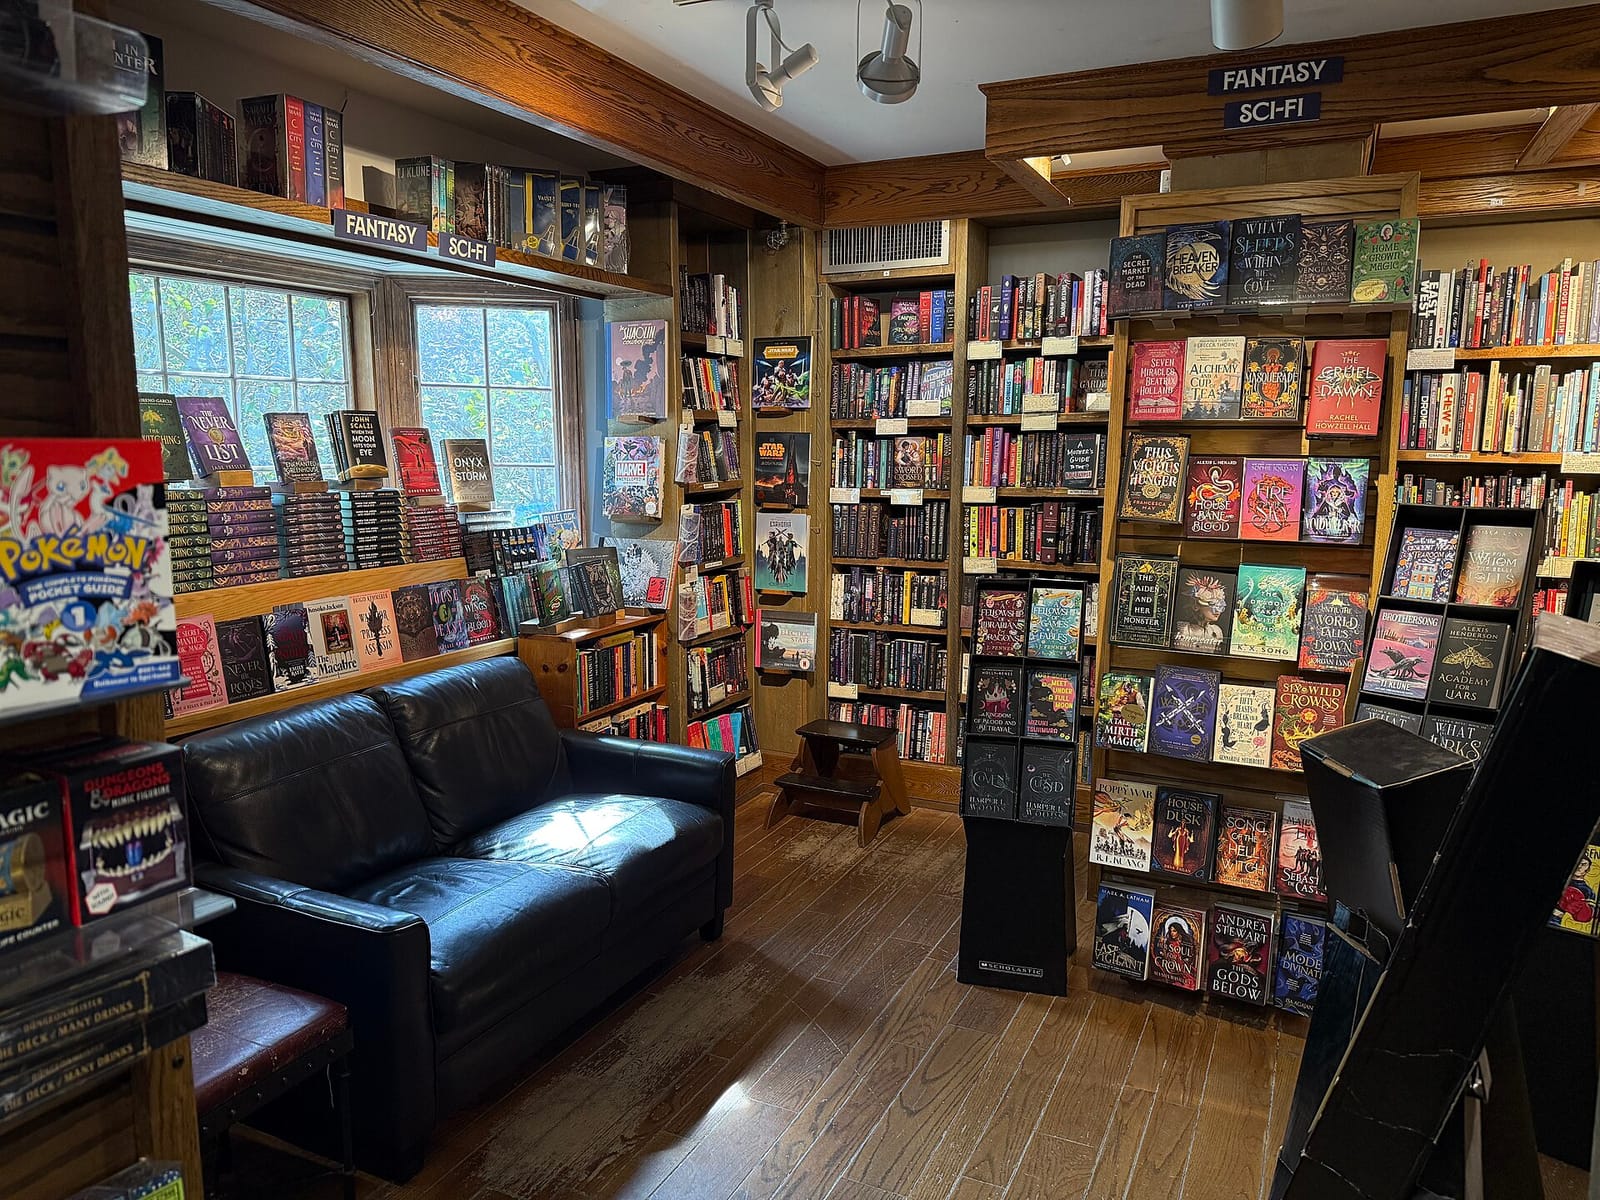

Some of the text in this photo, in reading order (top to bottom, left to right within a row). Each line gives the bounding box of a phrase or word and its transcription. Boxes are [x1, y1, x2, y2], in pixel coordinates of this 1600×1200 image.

[1223, 60, 1327, 91] FANTASY
[1239, 97, 1304, 124] SCI-FI
[289, 134, 303, 143] CITY
[310, 140, 322, 149] CITY
[406, 165, 431, 178] KLUNE
[346, 215, 417, 245] FANTASY
[1246, 220, 1285, 235] WHAT
[449, 237, 487, 262] SCI-FI
[1234, 233, 1295, 255] SLEEPS
[1372, 243, 1399, 253] HOME
[1123, 260, 1150, 268] SECRET
[1173, 251, 1218, 264] HEAVEN
[1244, 254, 1282, 268] WITHIN
[1369, 253, 1400, 263] GROWN
[1122, 267, 1151, 276] MARKET
[1173, 261, 1218, 275] BREAKER
[1298, 265, 1348, 274] VENGEANCE
[1369, 262, 1399, 272] MAGIC
[1125, 281, 1146, 289] DEAD
[1561, 271, 1570, 305] PRECIOUS
[1418, 280, 1430, 318] WEST
[1428, 282, 1439, 316] EAST
[622, 326, 656, 340] SHAOLIN
[1150, 358, 1175, 368] SEVEN
[1189, 364, 1239, 375] ALCHEMY
[1140, 367, 1176, 377] MIRACLES
[1244, 372, 1299, 383] MASQUERADE
[1321, 365, 1375, 380] CRUEL
[1145, 377, 1177, 386] BEATRIX
[1139, 386, 1174, 396] HOLLAND
[1191, 387, 1216, 400] TEA
[1320, 384, 1373, 397] DAWN
[1442, 386, 1454, 423] CHEW
[1418, 395, 1429, 429] DROME
[187, 415, 237, 433] NEVER
[1315, 422, 1371, 431] HOWZELL HALL
[203, 443, 240, 464] LIST
[759, 449, 785, 457] WARS
[1144, 447, 1174, 459] THIS
[454, 457, 484, 468] ONYX
[1133, 459, 1180, 474] VICIOUS
[455, 471, 488, 481] STORM
[617, 462, 646, 478] MARVEL
[894, 473, 923, 481] CROSSED
[895, 466, 922, 474] SWORD
[1129, 471, 1177, 489] HUNGER
[1256, 482, 1292, 502] FIRE
[1194, 500, 1231, 510] HOUSE
[542, 510, 576, 525] BLUE LOCK
[1251, 504, 1288, 529] SKY
[1191, 521, 1230, 532] BLOOD
[1467, 550, 1518, 568] WHOM
[1138, 574, 1153, 582] THE
[28, 584, 126, 604] POCKET GUIDE
[1129, 584, 1160, 593] MAIDEN
[465, 600, 488, 612] WINGS
[980, 609, 1025, 617] FELLOWSHIP
[71, 605, 86, 627] 1
[1123, 616, 1160, 626] MONSTER
[1315, 614, 1359, 630] WORLD
[1382, 612, 1439, 627] BROTHERSONG
[1040, 620, 1069, 629] GAMES
[1039, 632, 1068, 642] FABLES
[1320, 625, 1349, 639] FALLS
[1450, 630, 1498, 640] HENDERSON
[1313, 638, 1356, 655] DOWN
[224, 660, 264, 677] NEVER
[319, 659, 357, 676] Macabre
[230, 678, 263, 694] ROSES
[1387, 679, 1411, 691] KLUNE
[1438, 673, 1491, 687] ACADEMY
[1052, 687, 1073, 695] UNDER
[1283, 683, 1341, 698] SIX WILD
[1445, 689, 1477, 701] LIARS
[1055, 701, 1073, 709] MOON
[1280, 693, 1340, 711] CROWNS
[977, 725, 1016, 735] BETRAYAL
[1104, 725, 1138, 737] MIRTH
[1436, 722, 1476, 740] WHAT
[1107, 736, 1141, 748] MAGIC
[83, 761, 166, 793] DUNGEONS
[101, 773, 172, 799] DRAGONS
[1099, 783, 1153, 799] POPPY WAR
[111, 784, 171, 809] MIMIC FIGURINE
[969, 796, 999, 804] HARPER
[1167, 797, 1203, 813] HOUSE
[1166, 809, 1201, 826] DUSK
[1226, 816, 1267, 833] SONG
[1231, 832, 1258, 843] OF THE
[1228, 843, 1260, 859] HELL
[1221, 857, 1265, 875] WITCH
[1101, 889, 1118, 897] MARK
[1126, 894, 1150, 904] LATHAM
[1217, 913, 1267, 933] ANDREA
[1215, 923, 1268, 944] STEWART
[1094, 941, 1121, 954] LAST
[1168, 943, 1193, 958] SOUL
[1094, 950, 1144, 972] VIGILANT
[1154, 956, 1194, 975] CROWN
[988, 962, 1042, 975] SCHOLASTIC
[1216, 968, 1259, 989] GODS
[1212, 979, 1261, 1001] BELOW
[17, 1032, 49, 1054] DECK
[57, 1017, 91, 1037] MANY
[94, 1000, 134, 1024] DRINKS
[26, 1082, 53, 1102] DECK
[63, 1064, 95, 1083] MANY
[97, 1042, 135, 1067] DRINKS
